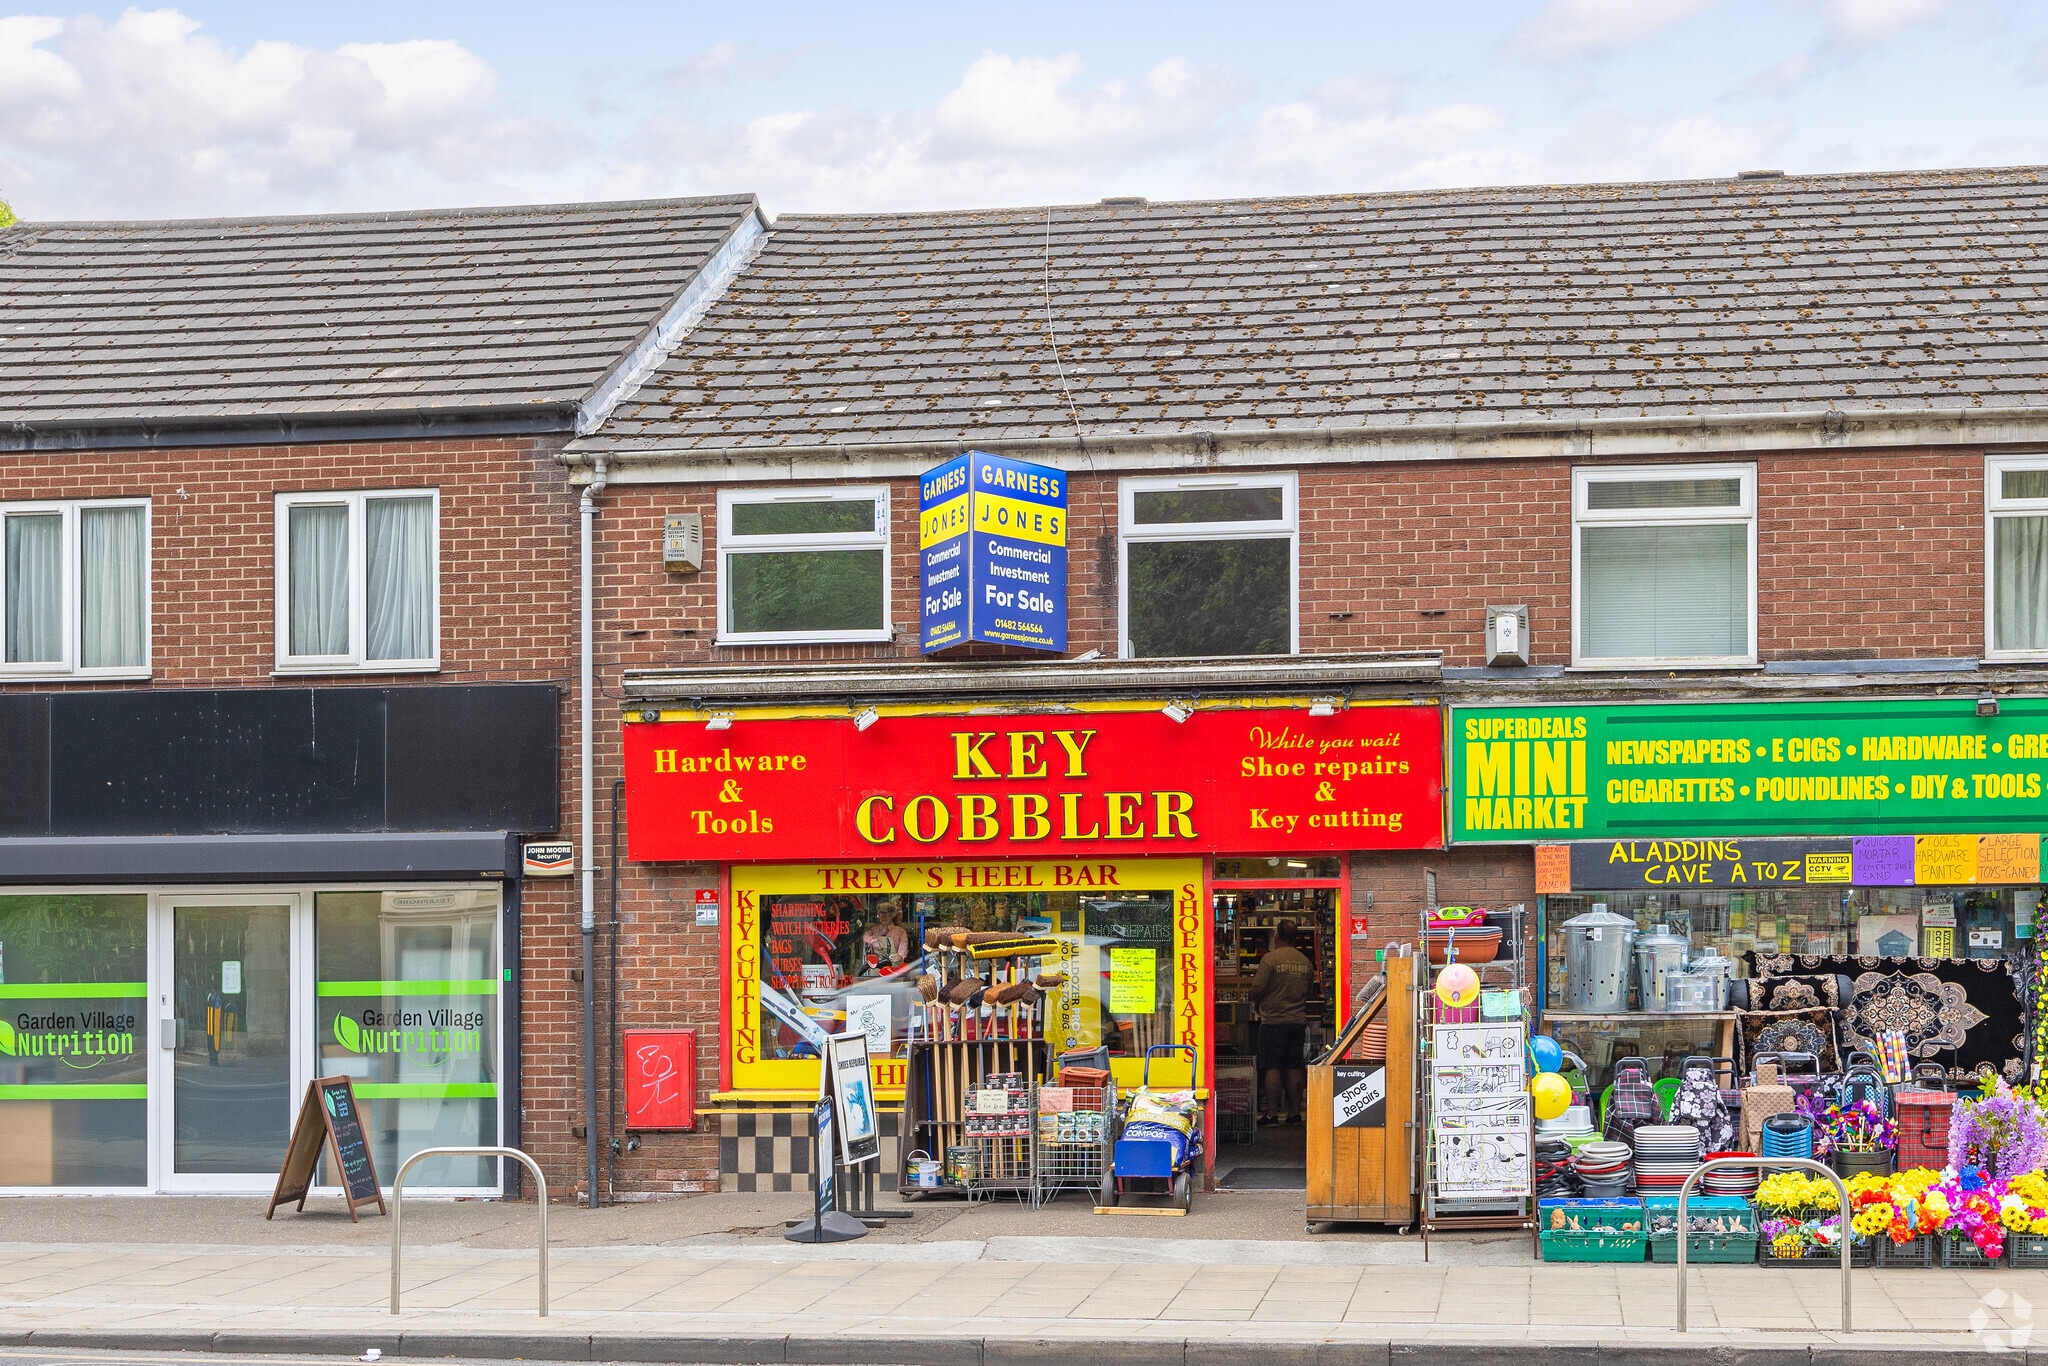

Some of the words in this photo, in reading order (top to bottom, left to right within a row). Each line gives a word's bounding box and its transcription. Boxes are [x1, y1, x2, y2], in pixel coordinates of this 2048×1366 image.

[923, 465, 966, 501] GARNESS
[981, 465, 1060, 498] GARNESS
[924, 505, 965, 538] JONES
[982, 504, 1059, 535] JONES
[927, 541, 961, 567] Commercial
[988, 540, 1051, 564] Commercial
[928, 564, 960, 587] Investment
[990, 561, 1050, 584] Investment
[925, 596, 941, 616] For
[942, 587, 962, 611] Sale
[985, 584, 1014, 608] For
[1018, 589, 1054, 614] Sale
[984, 629, 1053, 646] www.garnessjones.co.uk
[995, 618, 1016, 630] 01482
[1017, 621, 1043, 634] 564564
[1465, 716, 1587, 740] SUPERDEALS
[1250, 726, 1314, 749] While
[1319, 739, 1354, 755] you
[1360, 732, 1401, 747] wait
[1606, 738, 1751, 764] NEWSPAPERS
[1772, 738, 1784, 762] E
[1788, 737, 1841, 762] CIGS
[1862, 735, 1987, 761] HARDWARE
[654, 748, 807, 773] Hardware
[950, 730, 1098, 780] KEY
[1241, 756, 1306, 777] Shoe
[1313, 755, 1410, 781] repairs
[1466, 740, 1586, 796] MINI
[719, 778, 744, 803] &
[1314, 781, 1337, 802] &
[1606, 777, 1735, 803] CIGARETTES
[1756, 775, 1890, 801] POUNDLINES
[1911, 775, 1949, 799] DIY
[1951, 777, 1969, 799] &
[1971, 773, 2041, 799] TOOLS
[691, 809, 774, 834] Tools
[854, 791, 1200, 844] COBBLER
[1249, 808, 1299, 834] Key
[1308, 807, 1403, 832] cutting
[1465, 796, 1588, 830] MARKET
[1609, 840, 1742, 864] ALADDINS
[1927, 836, 1960, 847] TOOLS
[1988, 835, 2022, 846] LARGE
[1809, 856, 1849, 864] WARNING
[1859, 848, 1900, 860] MORTAR
[1915, 849, 1970, 862] HARDWARE
[1978, 847, 2039, 863] SELECTION
[817, 867, 906, 889] TREV
[954, 865, 1043, 888] HEEL
[1053, 864, 1121, 886] BAR
[1644, 863, 1714, 884] CAVE
[1730, 862, 1748, 883] A
[1751, 862, 1779, 881] TO
[1782, 860, 1801, 881] Z
[1857, 863, 1893, 872] CEMENT
[1862, 872, 1892, 881] SAND
[735, 890, 756, 941] KEY
[771, 903, 827, 917] SHARPENING
[1178, 883, 1200, 949] SHOE
[771, 921, 802, 935] WATCH
[804, 921, 850, 935] BATTERIES
[1122, 923, 1171, 938] REPAIRS
[771, 940, 793, 954] BAGS
[1061, 940, 1069, 954] NO
[771, 957, 803, 972] PURSES
[1061, 956, 1069, 976] JOB
[1070, 938, 1080, 1005] BULLDOZER
[771, 975, 812, 989] SHOPPING
[736, 944, 756, 1065] CUTTING
[1061, 990, 1070, 1010] TOO
[1179, 953, 1200, 1064] REPAIRS
[17, 1012, 75, 1030] Garden
[80, 1011, 135, 1033] Village
[362, 1009, 422, 1026] Garden
[428, 1009, 484, 1031] Village
[1062, 1013, 1070, 1031] BIG.
[1071, 1007, 1081, 1031] PRO
[18, 1030, 133, 1056] Nutrition
[362, 1027, 481, 1053] Nutrition
[1336, 1070, 1346, 1078] key
[1347, 1070, 1366, 1078] cutting
[1341, 1082, 1368, 1103] Shoe
[1342, 1089, 1380, 1117] Repairs
[1126, 1130, 1170, 1139] COMPOST
